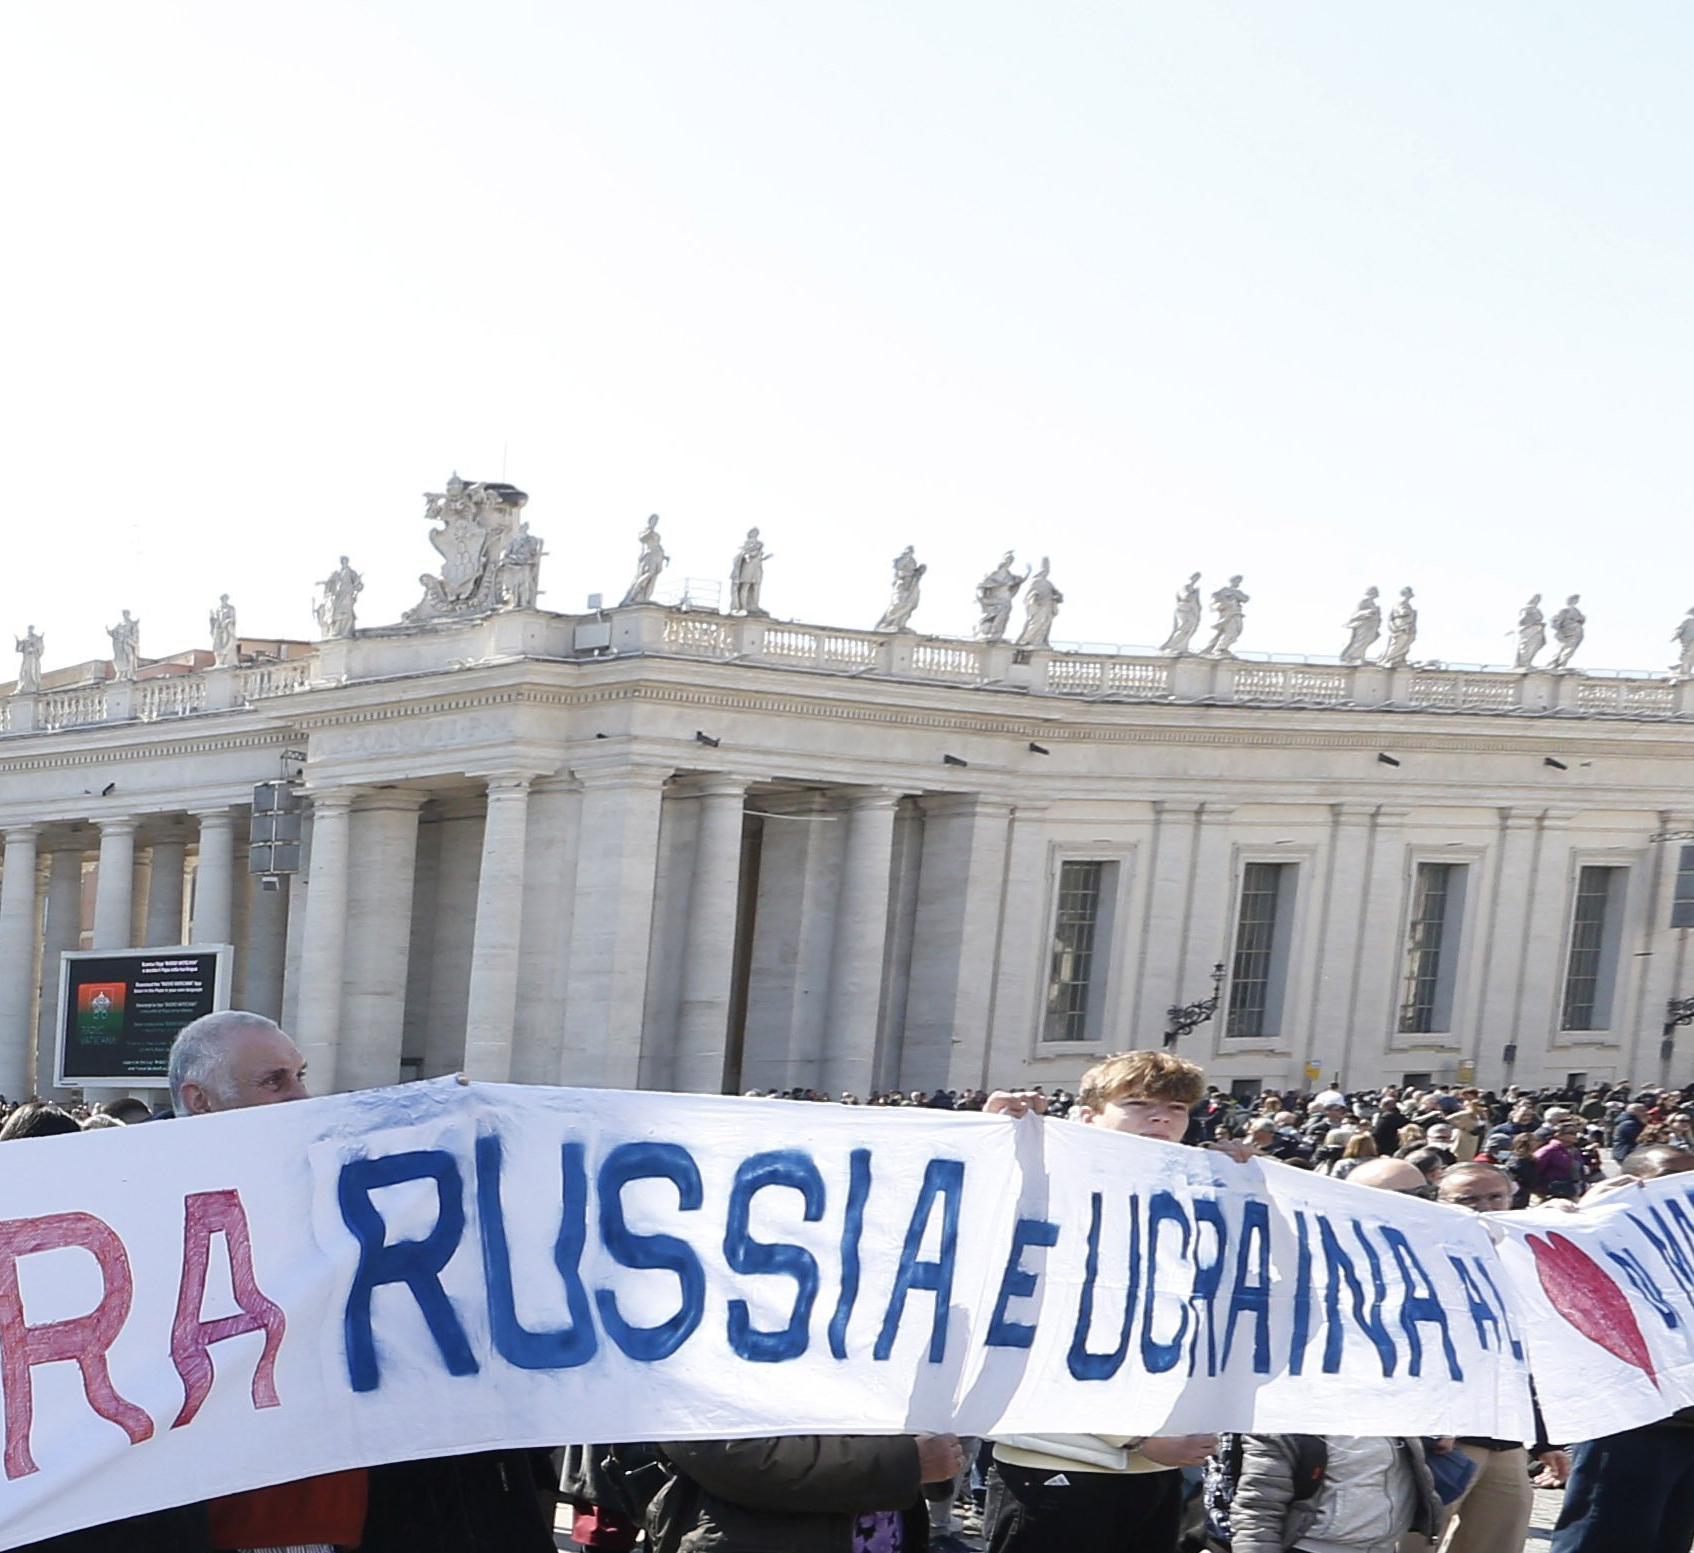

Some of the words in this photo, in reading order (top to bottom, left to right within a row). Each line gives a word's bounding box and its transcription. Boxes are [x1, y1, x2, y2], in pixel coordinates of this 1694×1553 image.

[337, 1133, 965, 1393] RUSSIA
[985, 1219, 1061, 1348] E
[1067, 1191, 1464, 1381] UCRAINA
[1447, 1256, 1524, 1361] AL
